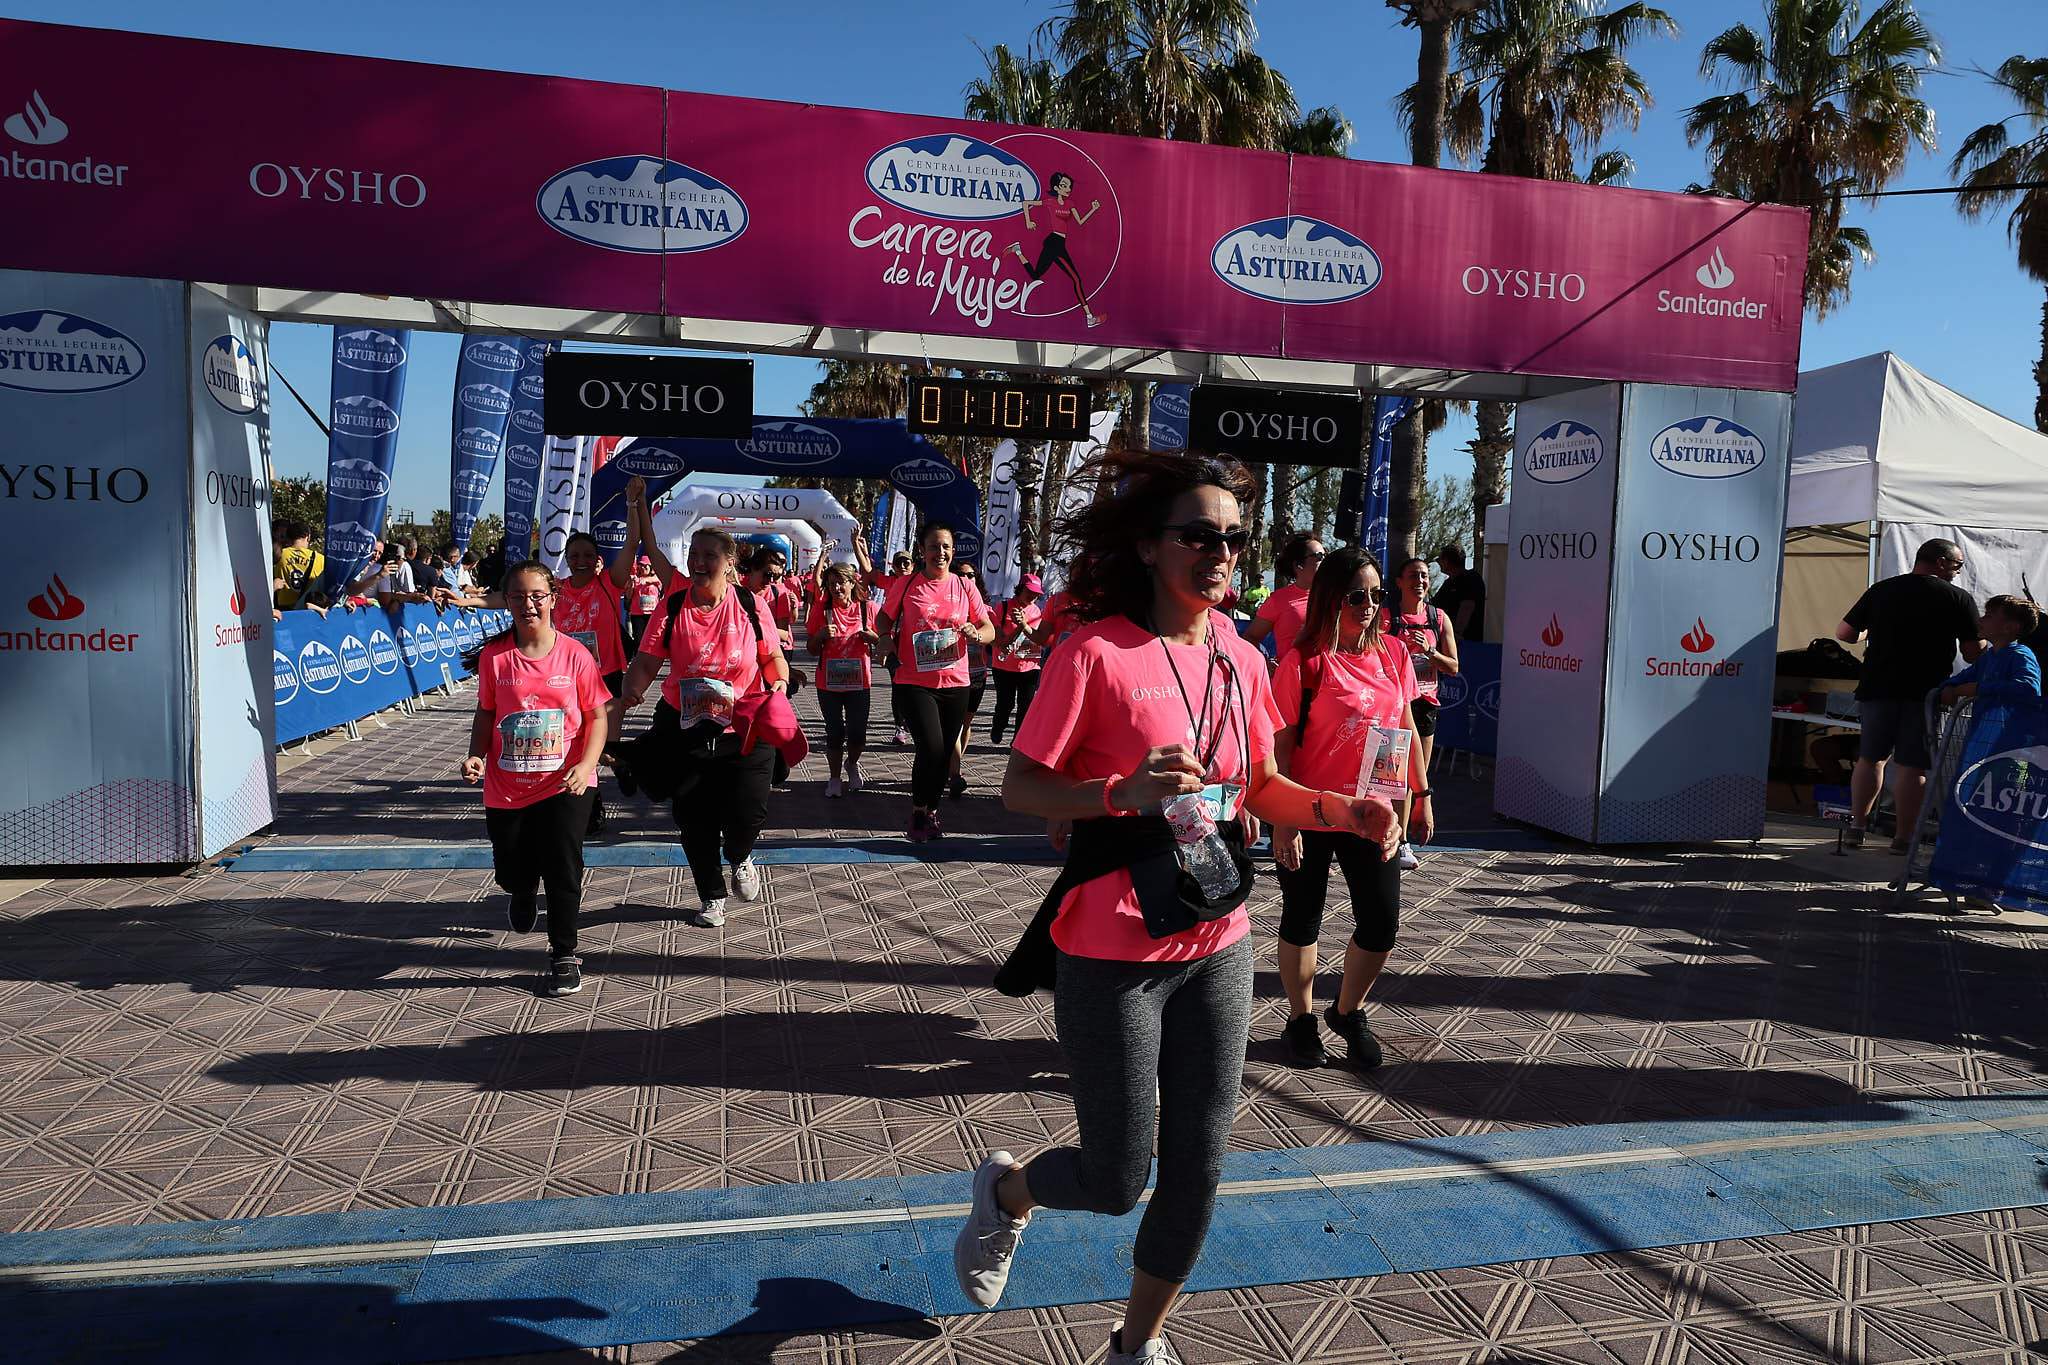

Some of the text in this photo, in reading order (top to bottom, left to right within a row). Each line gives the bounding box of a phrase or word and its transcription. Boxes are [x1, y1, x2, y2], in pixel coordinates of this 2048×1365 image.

[879, 159, 1026, 204] ASTURIANA
[907, 160, 1023, 179] CENTRAL LECHERA
[249, 163, 427, 208] OYSHO
[586, 185, 726, 205] CENTRAL LECHERA
[553, 185, 733, 233] ASTURIANA
[849, 205, 992, 259] Carrera
[1224, 243, 1369, 286] ASTURIANA
[1251, 243, 1365, 260] CENTRAL LECHERA
[883, 254, 1045, 328] de la Mujer
[1462, 266, 1586, 302] OYSHO
[1657, 290, 1768, 320] Santander
[63, 340, 126, 352] LECHERA
[207, 355, 261, 401] ASTURIANA
[579, 380, 725, 414] OYSHO
[921, 386, 1077, 429] 01:10:19
[1218, 410, 1338, 444] OYSHO
[1676, 436, 1754, 448] CENTRAL LECHERA
[743, 438, 833, 456] ASTURIANA
[1528, 446, 1597, 472] ASTURIANA
[1658, 437, 1757, 467] ASTURIANA
[620, 456, 680, 472] ASTURIANA
[895, 467, 951, 482] ASTURIANA
[206, 470, 265, 510] OYSHO
[544, 435, 577, 558] OYSH
[717, 492, 800, 512] OYSHO
[986, 461, 1016, 575] OYSHO
[1520, 531, 1598, 560] OYSHO
[1641, 531, 1761, 563] OYSHO
[215, 621, 262, 648] Santander
[303, 662, 340, 683] ASTURIANA
[1519, 649, 1584, 673] Santander
[1645, 656, 1745, 677] Santander
